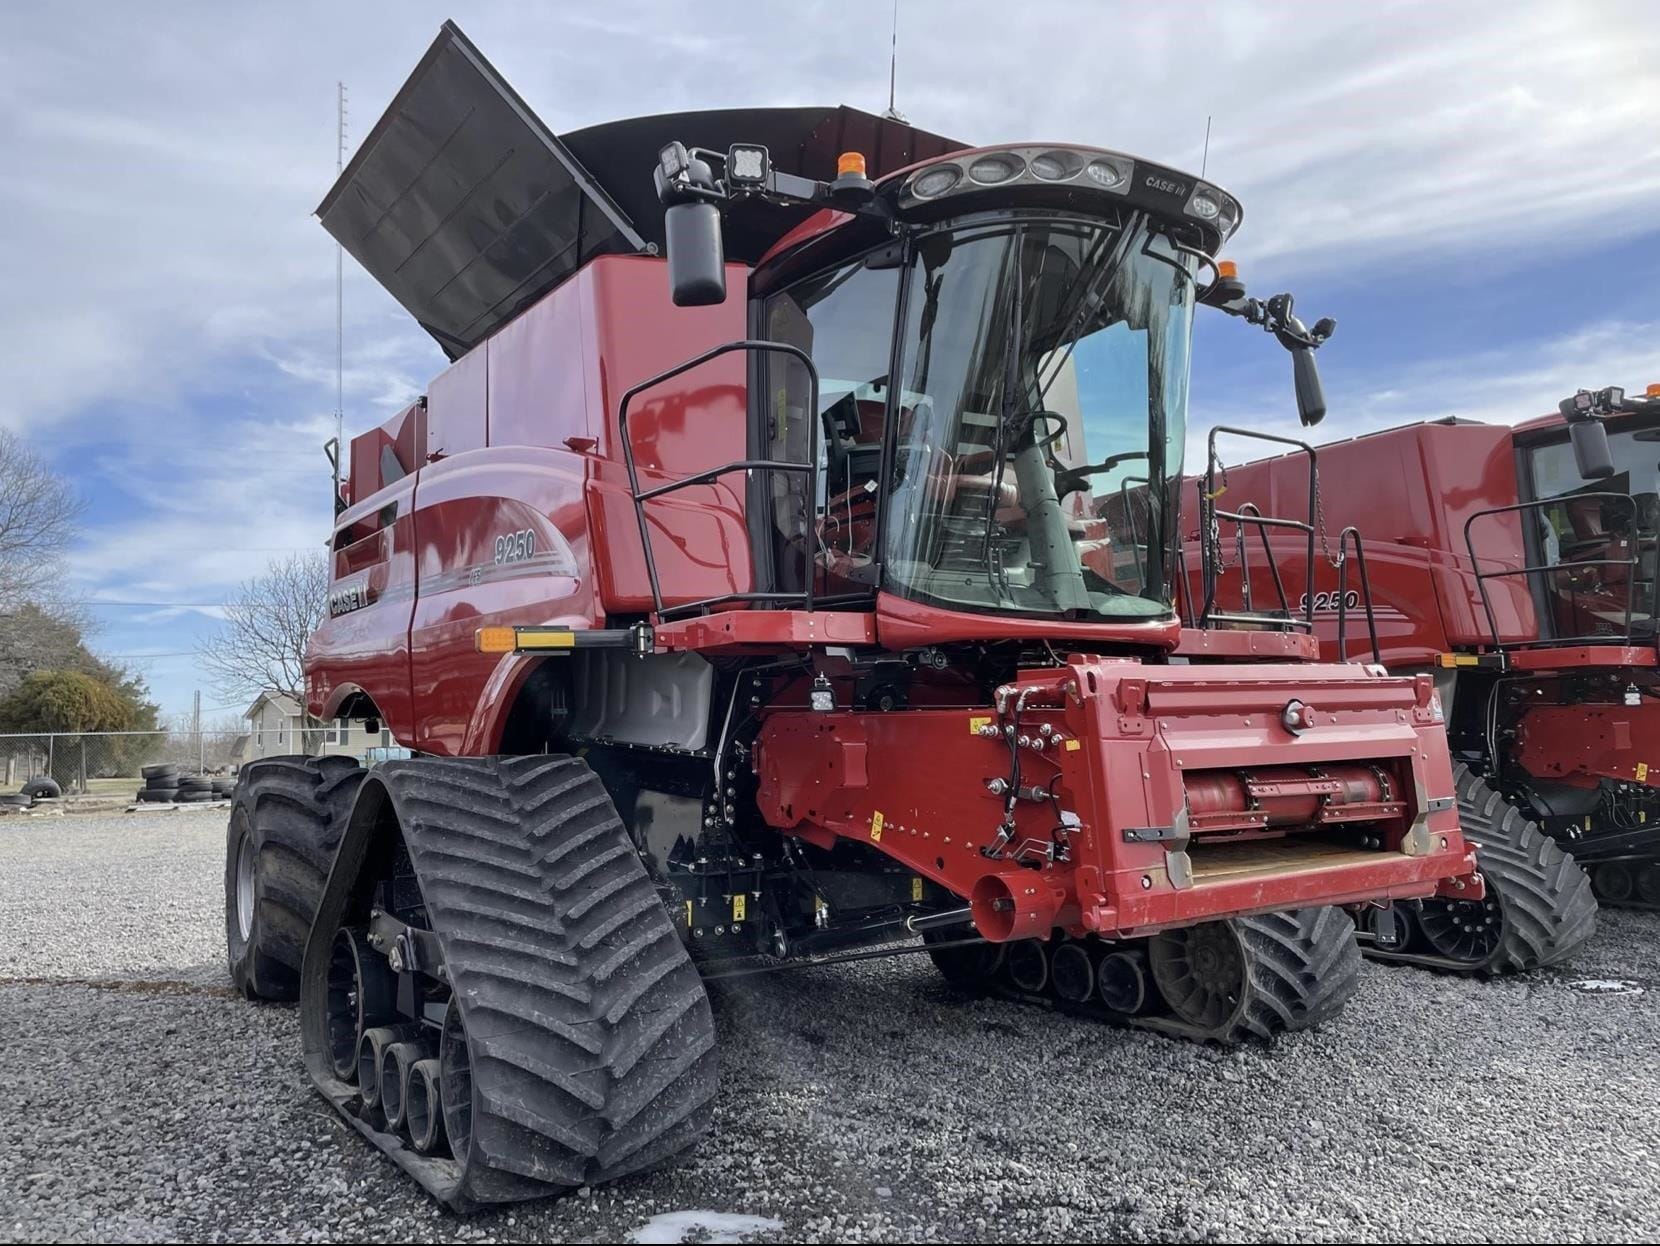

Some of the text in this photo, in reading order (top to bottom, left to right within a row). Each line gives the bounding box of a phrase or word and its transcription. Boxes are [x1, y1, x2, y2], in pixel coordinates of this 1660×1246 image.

[1145, 176, 1175, 192] CASE
[494, 528, 535, 566] 9250
[330, 588, 358, 614] CASE
